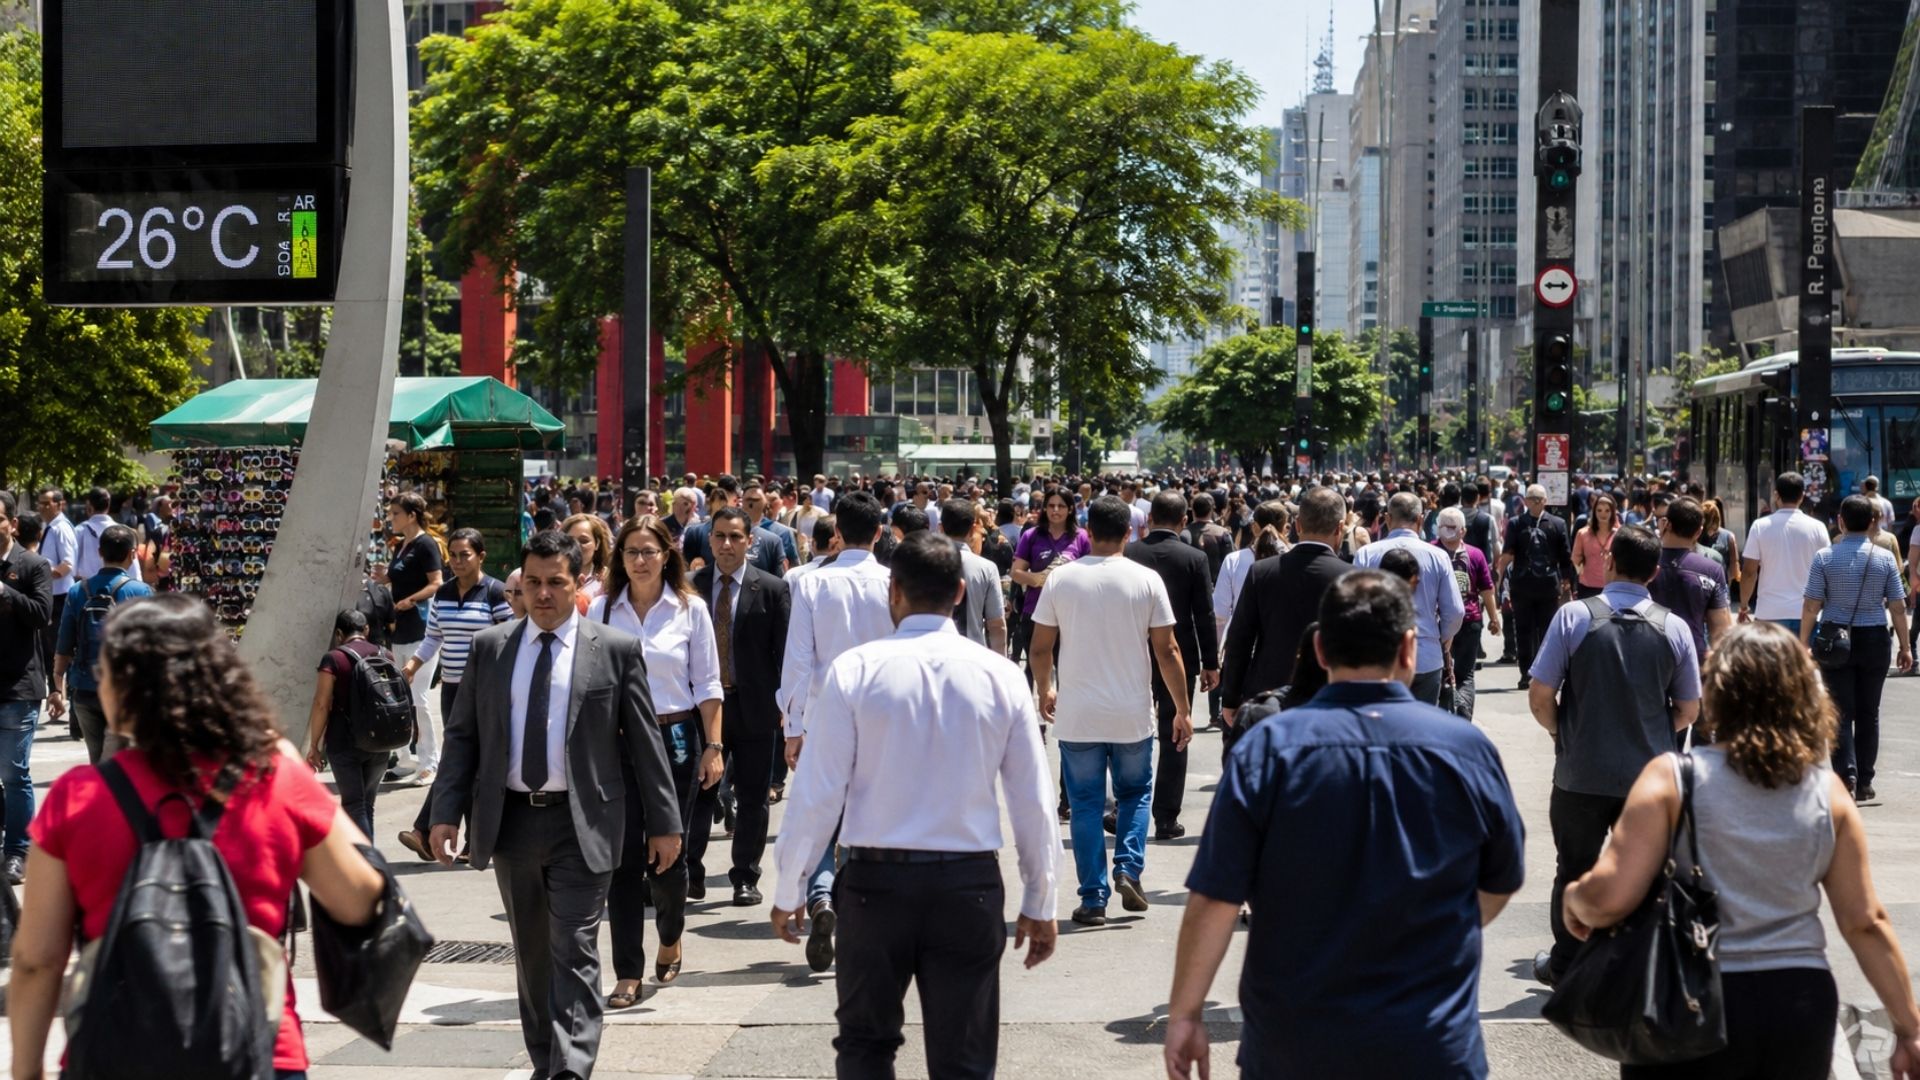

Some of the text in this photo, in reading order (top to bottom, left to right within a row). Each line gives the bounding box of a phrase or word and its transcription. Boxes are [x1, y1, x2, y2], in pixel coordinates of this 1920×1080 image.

[293, 194, 316, 210] AR
[96, 204, 260, 270] 26°C
[1807, 274, 1824, 295] R.
